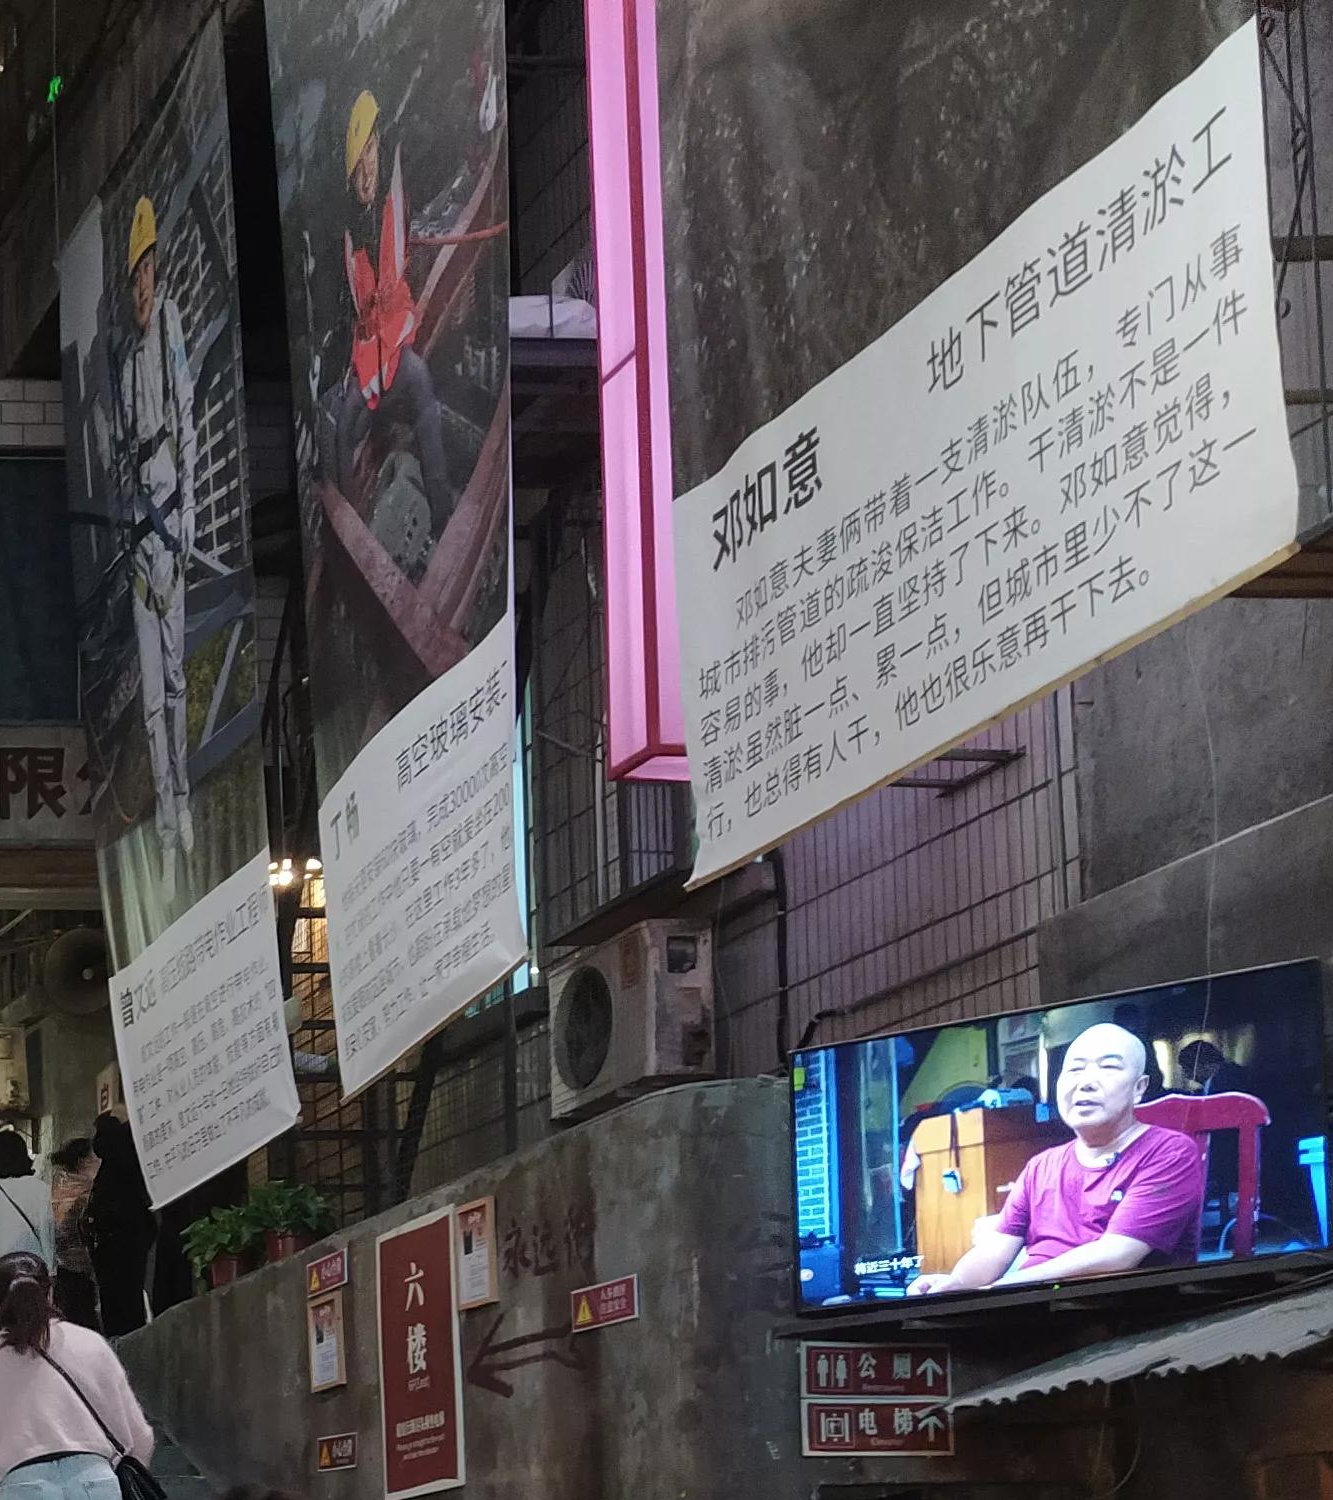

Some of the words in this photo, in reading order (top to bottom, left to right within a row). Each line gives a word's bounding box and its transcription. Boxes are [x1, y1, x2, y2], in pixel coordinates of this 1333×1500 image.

[925, 106, 1232, 393] 地下管道清淤工
[711, 426, 824, 573] 邓如意
[404, 1261, 428, 1375] 六楼
[858, 1407, 914, 1436] 电梯
